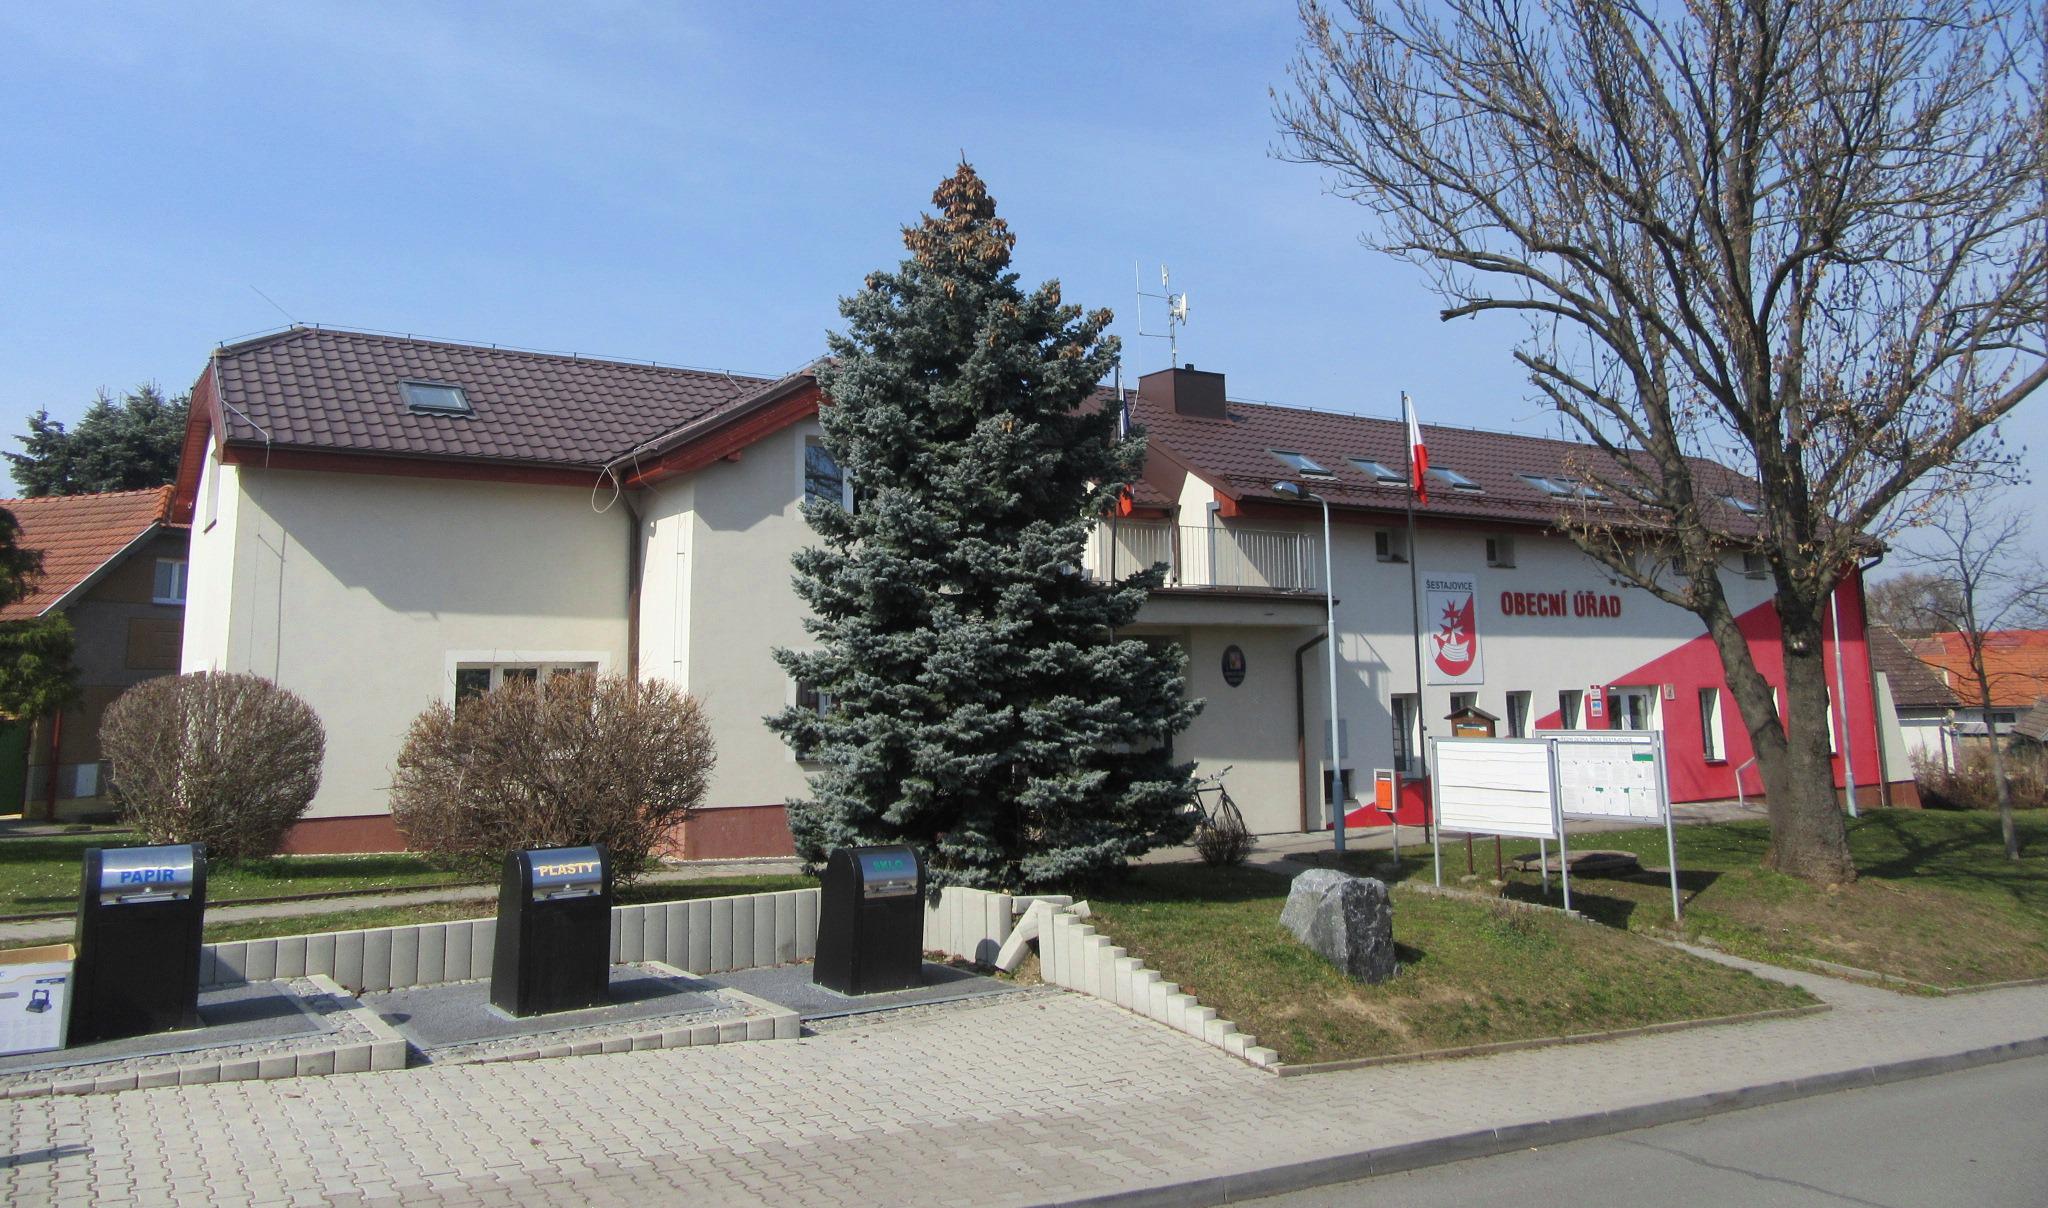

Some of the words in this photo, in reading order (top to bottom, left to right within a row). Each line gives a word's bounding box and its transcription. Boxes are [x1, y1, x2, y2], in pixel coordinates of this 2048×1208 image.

[1425, 579, 1473, 590] ŠESTAJOVICE
[1500, 590, 1567, 616] OBECNÍ
[1573, 590, 1621, 617] ÚŘAD
[539, 862, 593, 877] PLASTY
